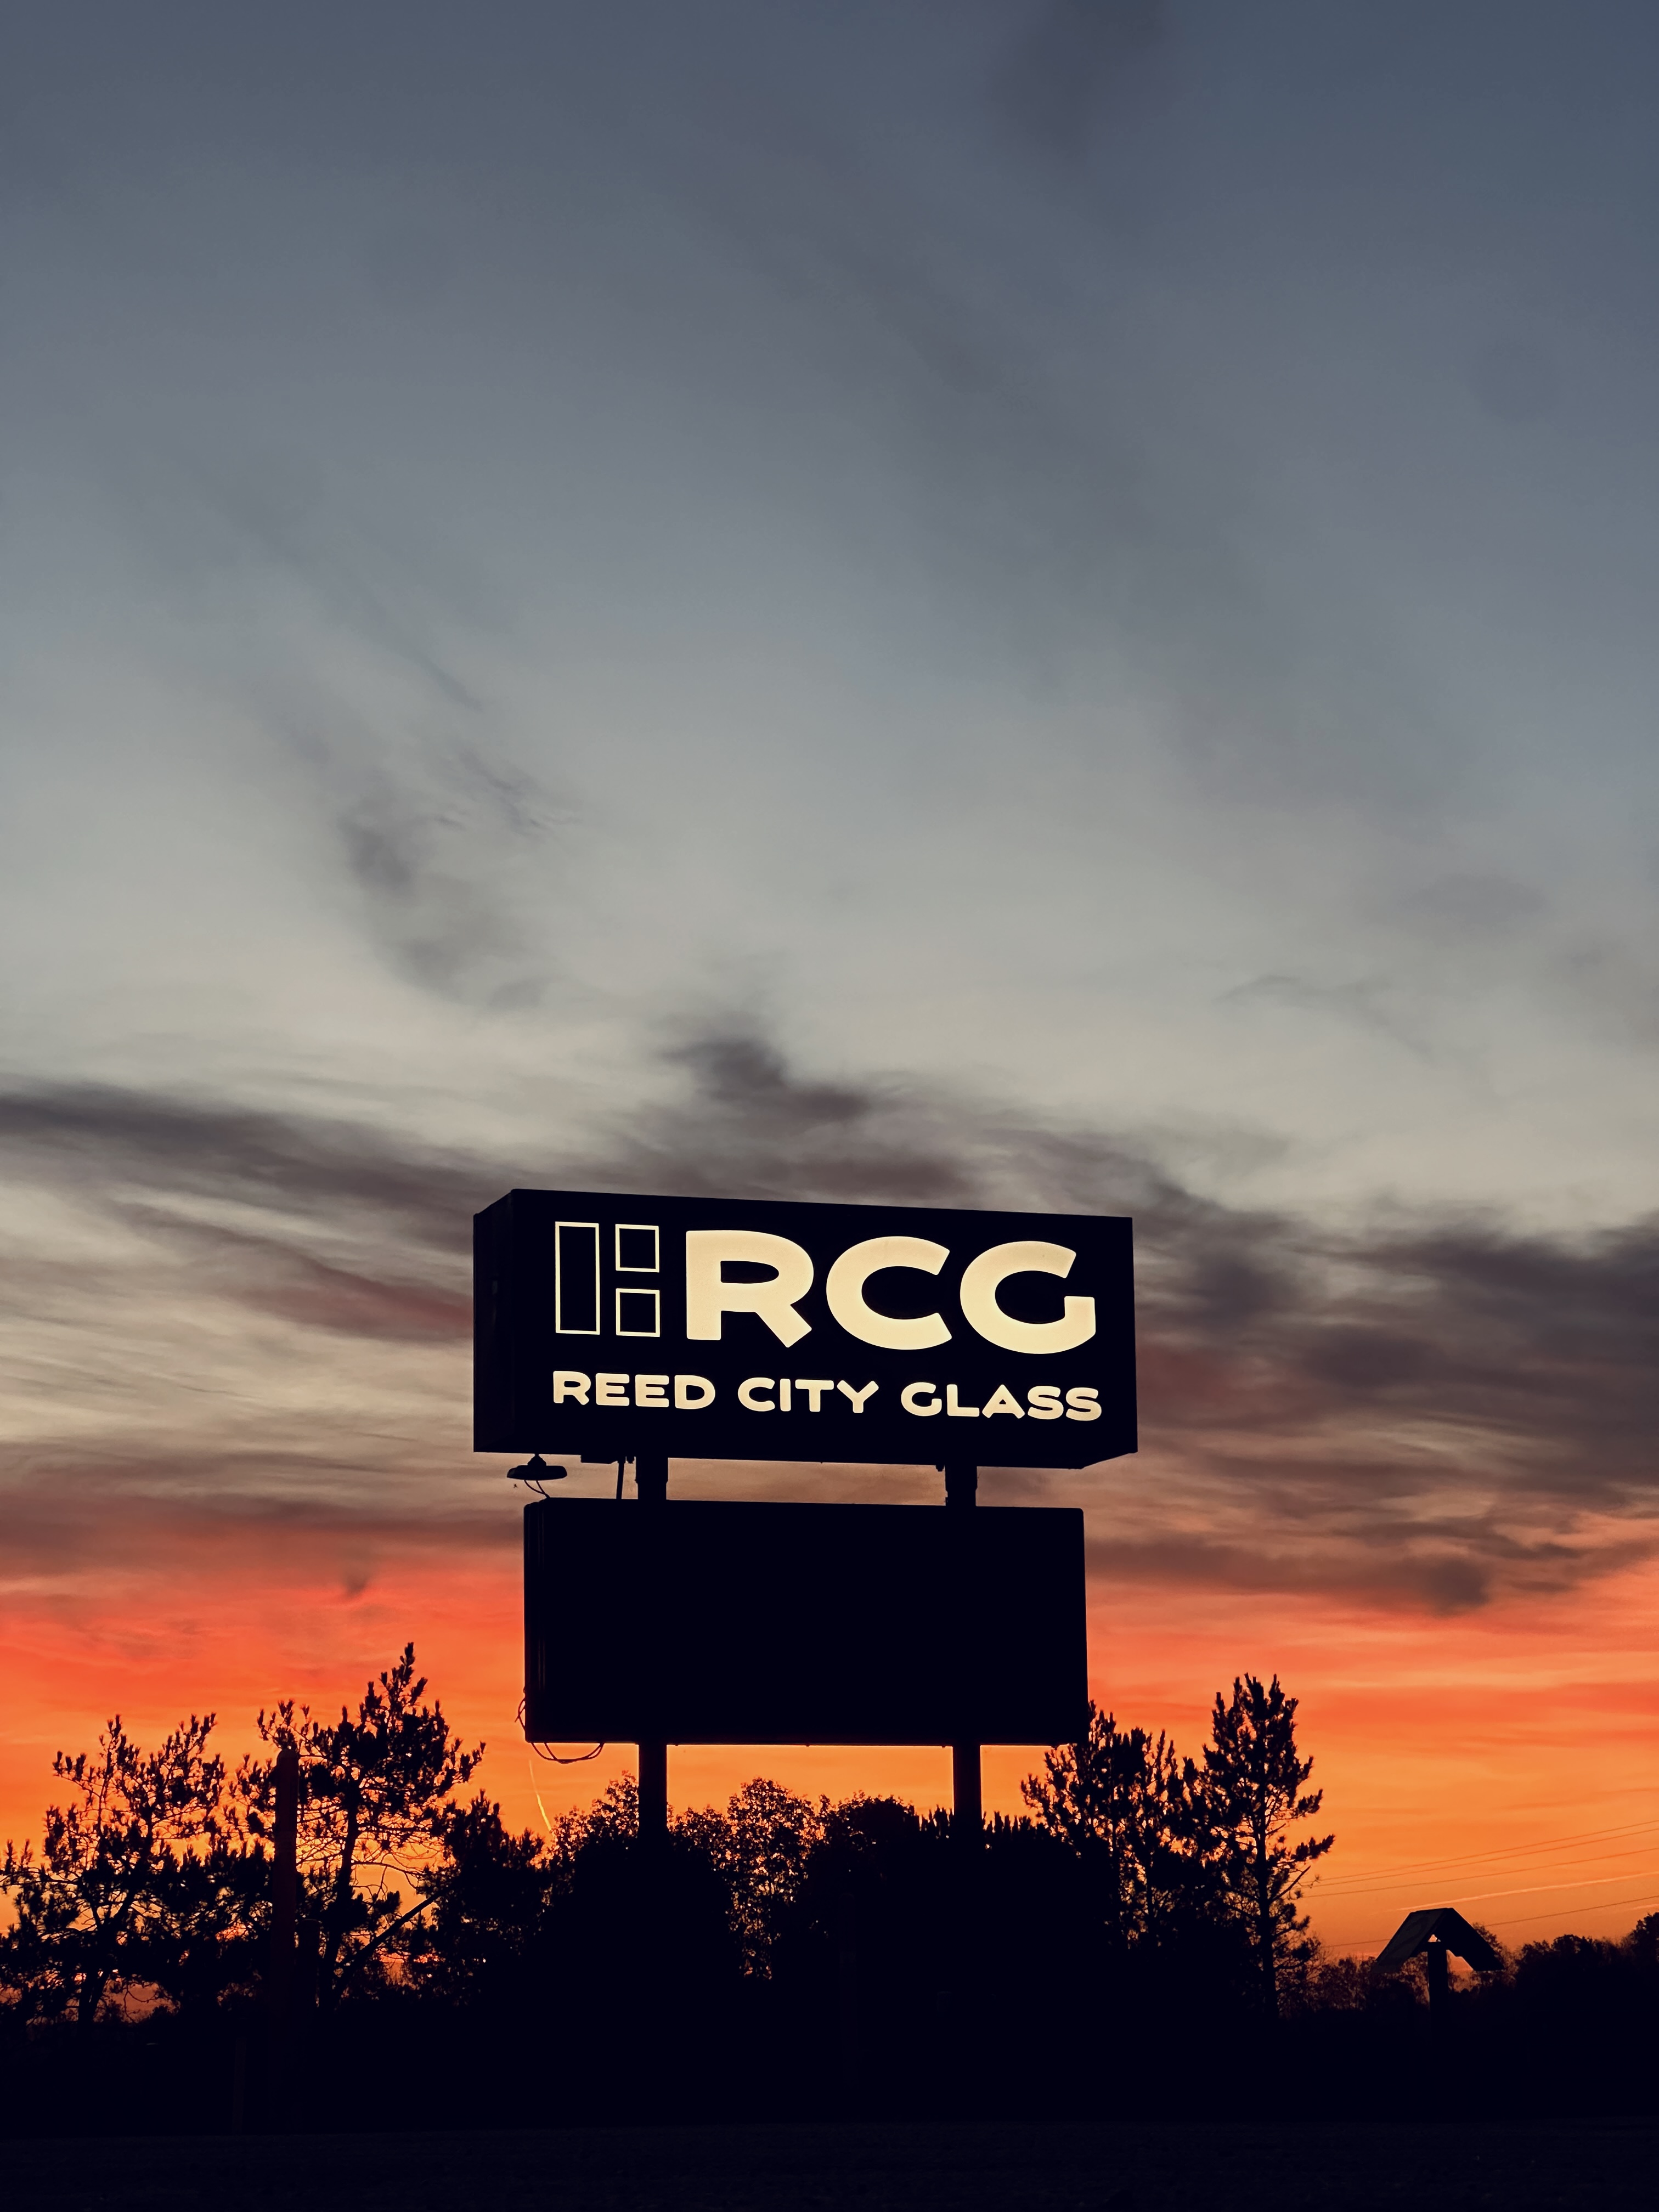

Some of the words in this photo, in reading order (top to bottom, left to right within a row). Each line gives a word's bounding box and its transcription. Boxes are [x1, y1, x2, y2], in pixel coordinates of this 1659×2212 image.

[685, 1229, 1096, 1355] RCG
[552, 1370, 716, 1410] REED
[737, 1377, 879, 1414] CITY
[901, 1381, 1102, 1421] GLASS
